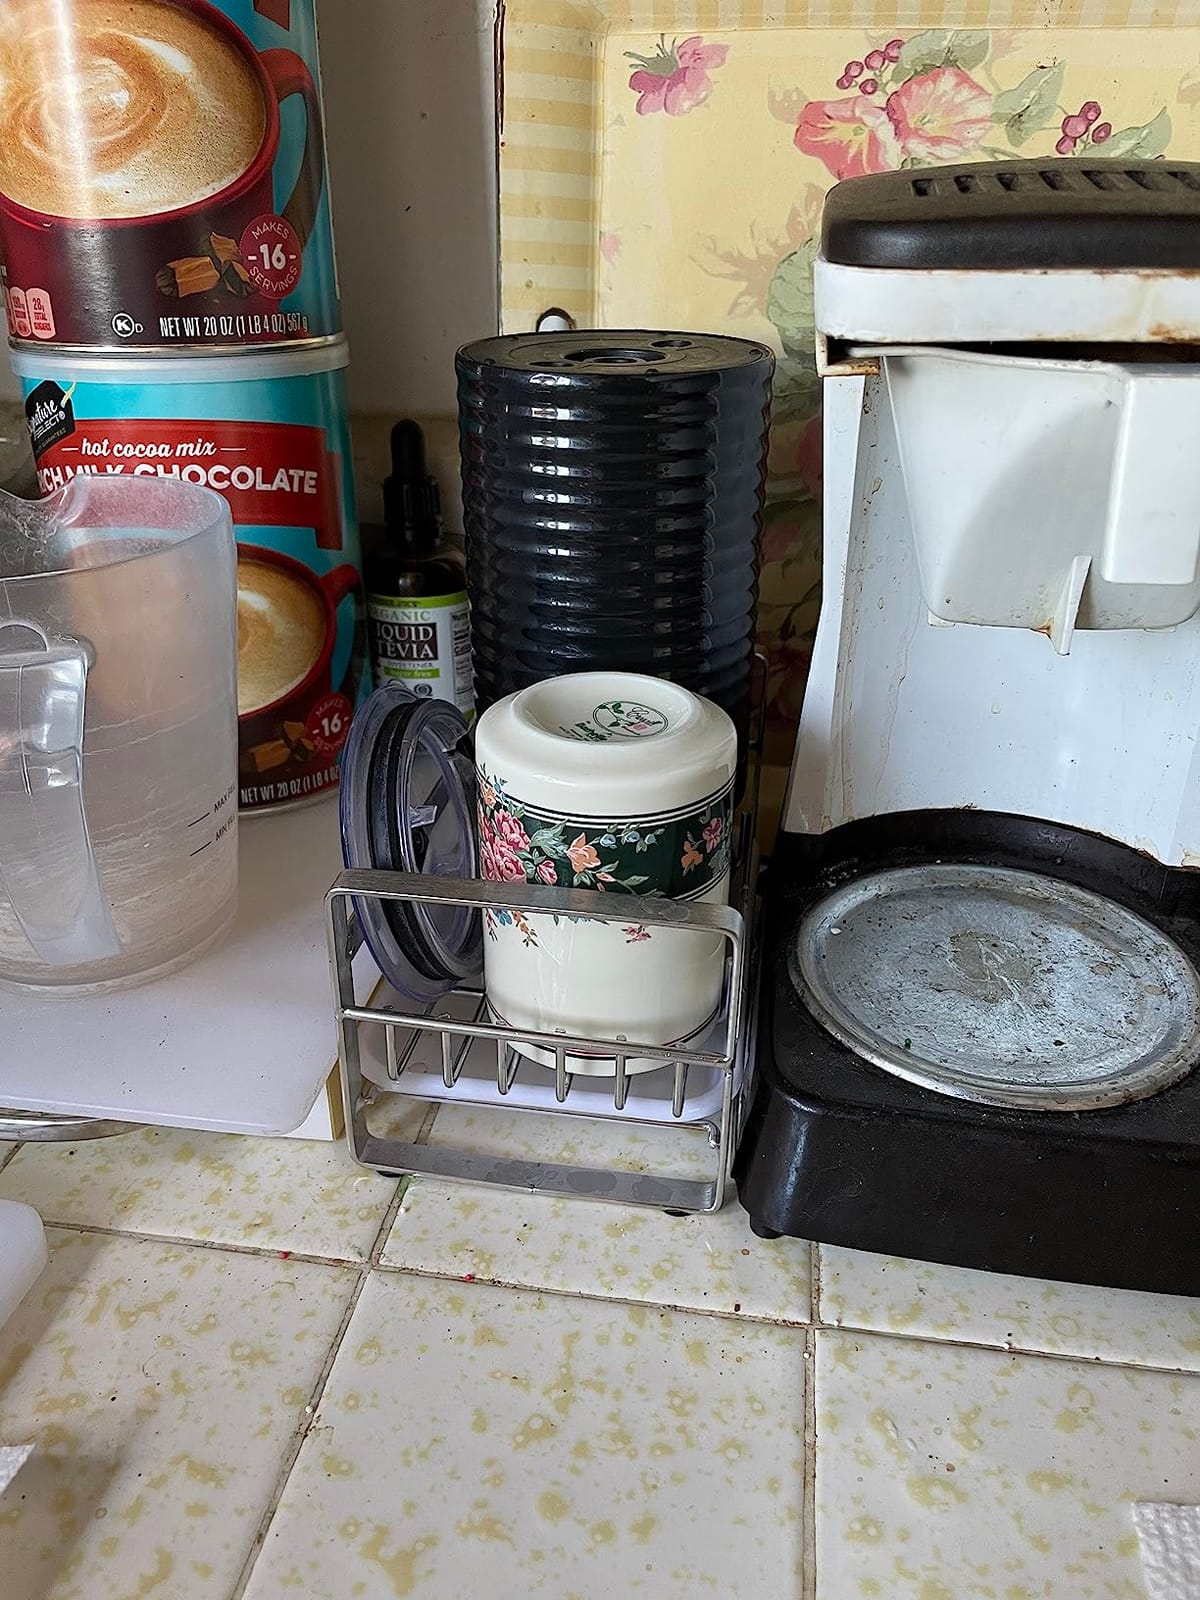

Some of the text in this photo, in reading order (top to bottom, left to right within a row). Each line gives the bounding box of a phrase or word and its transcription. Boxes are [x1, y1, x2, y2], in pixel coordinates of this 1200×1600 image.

[251, 221, 290, 239] MAKES
[260, 243, 286, 270] 16
[249, 265, 298, 292] SERVINGS
[159, 317, 180, 337] NET
[182, 317, 200, 337] WT
[203, 316, 217, 336] 20
[219, 316, 234, 336] OZ
[236, 315, 246, 337] (1
[249, 315, 262, 334] LB
[263, 315, 270, 333] 4
[271, 314, 286, 334] OZ)
[302, 316, 309, 333] g
[81, 437, 111, 456] hot
[112, 442, 173, 458] cocoa
[175, 438, 217, 457] mix
[36, 465, 64, 493] ICH
[321, 712, 342, 737] 16
[241, 787, 258, 804] NET
[260, 784, 275, 801] WT
[277, 782, 288, 798] 20
[290, 778, 301, 795] OZ
